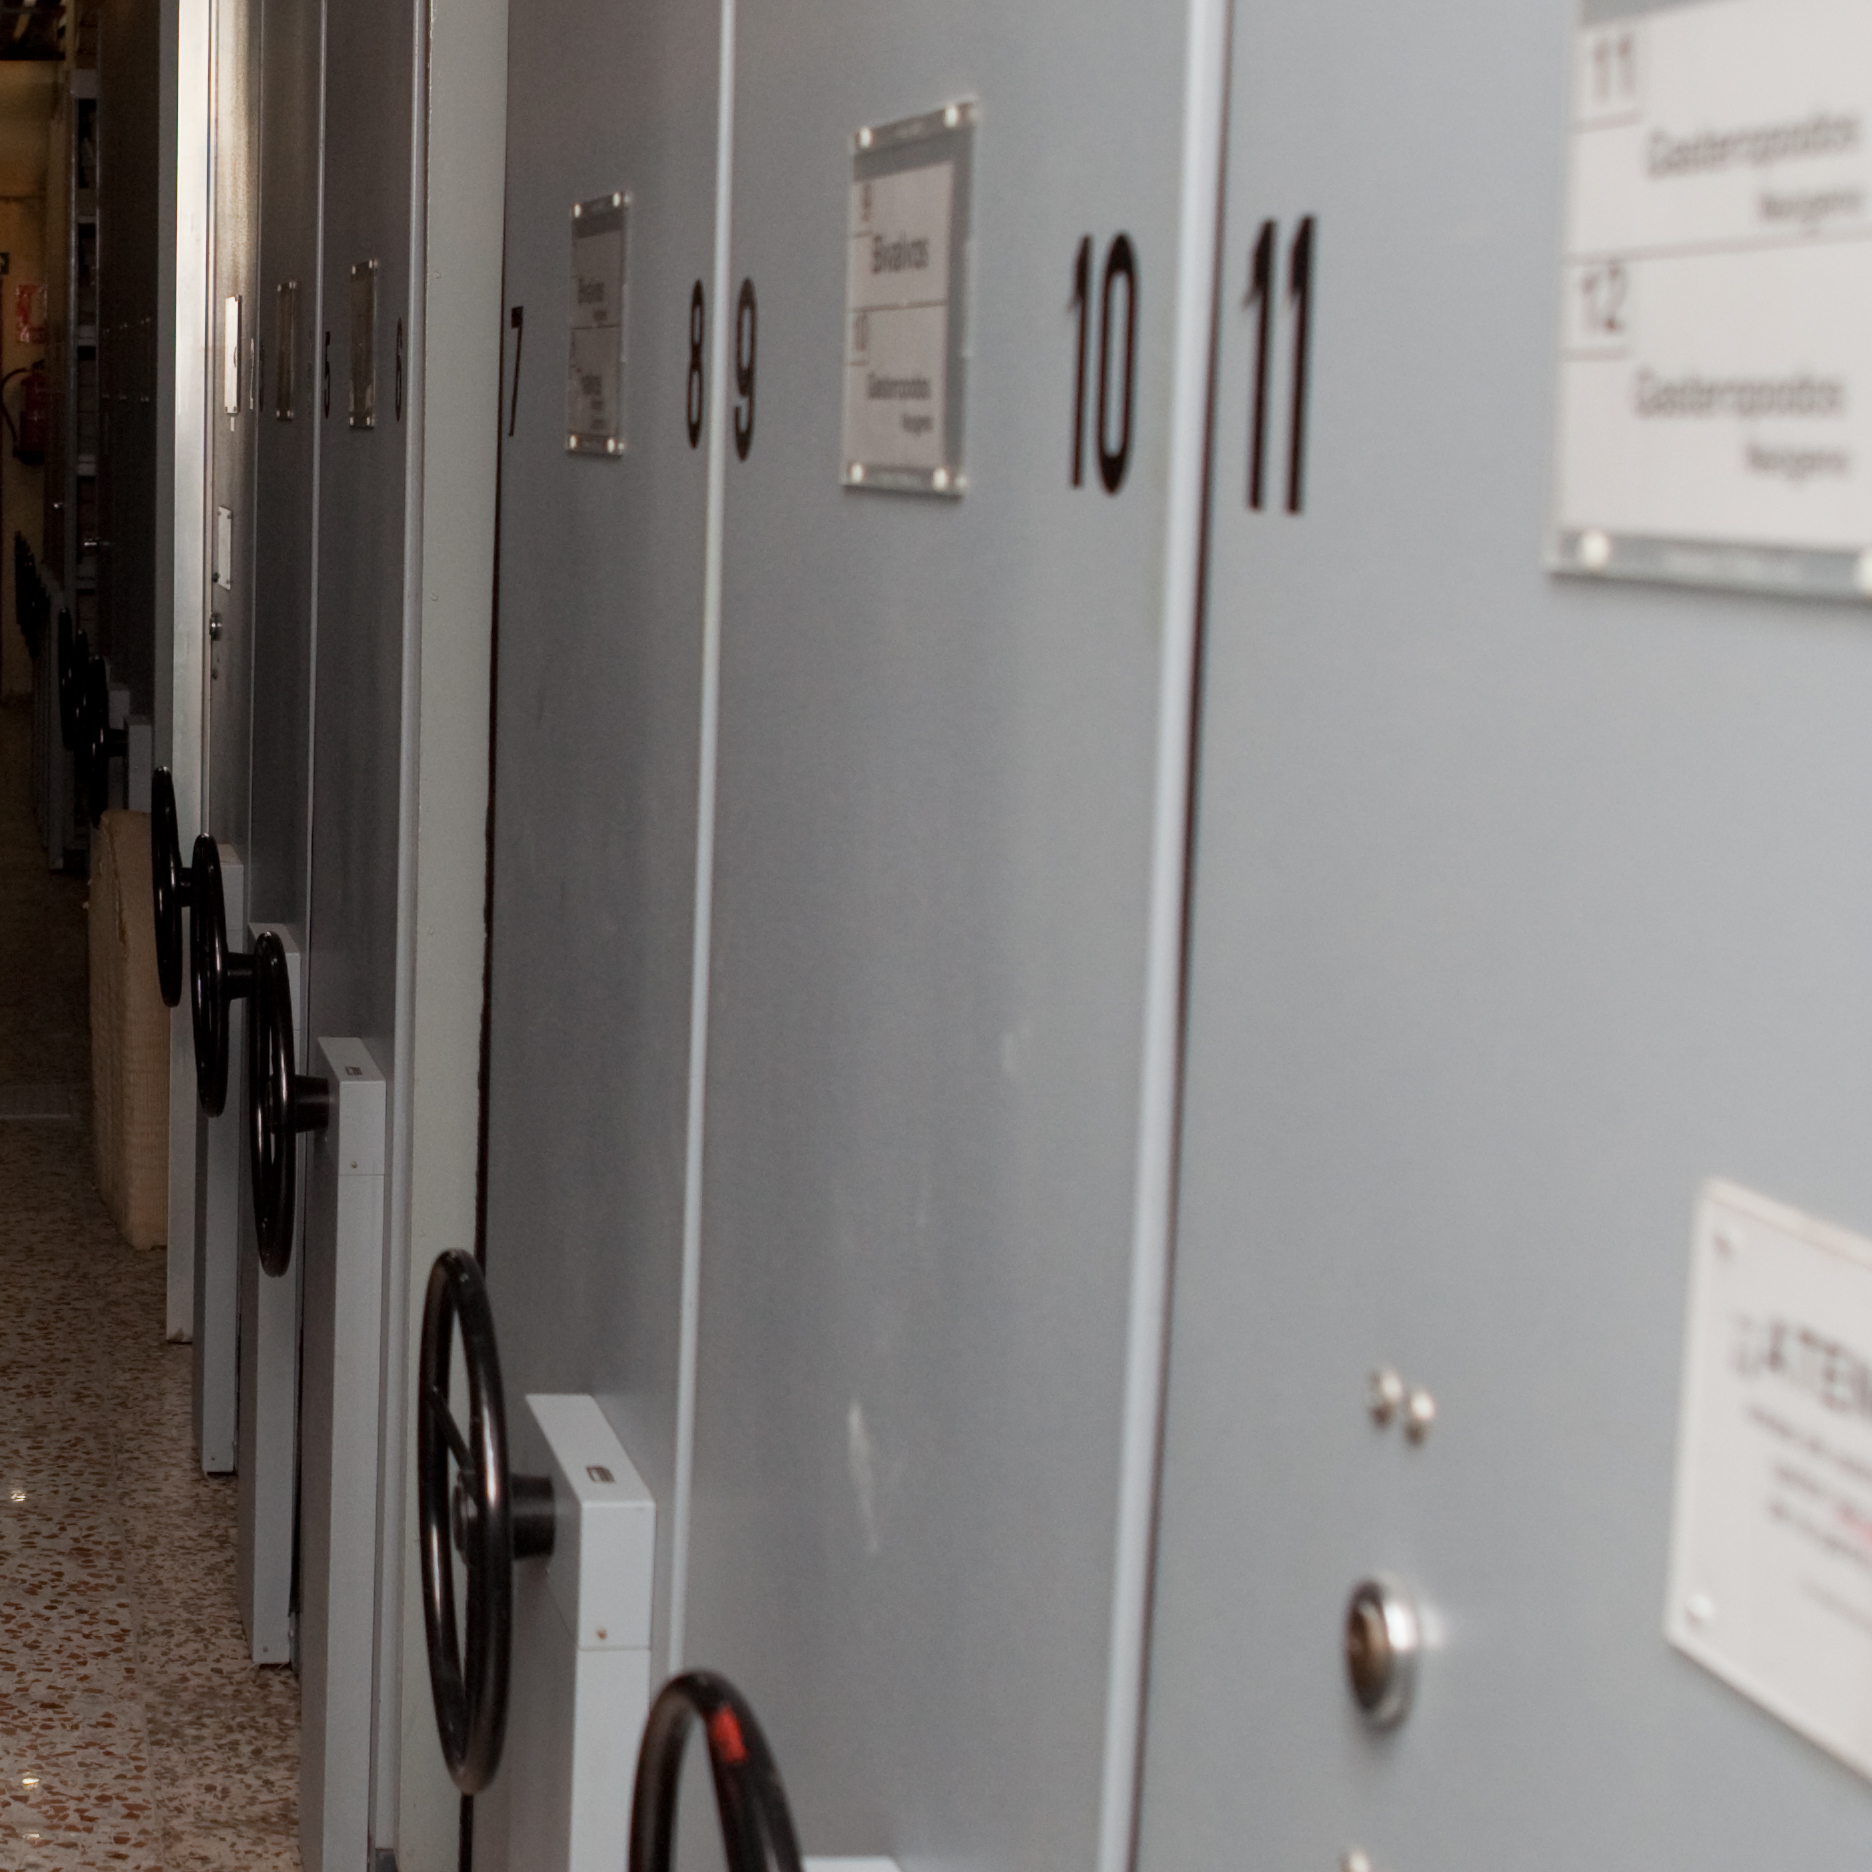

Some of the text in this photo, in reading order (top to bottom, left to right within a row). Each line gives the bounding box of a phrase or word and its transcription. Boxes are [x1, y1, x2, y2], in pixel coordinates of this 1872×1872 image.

[1591, 31, 1637, 105] 11
[324, 330, 331, 419] 5
[395, 317, 403, 422] 6
[508, 305, 524, 437] 7
[687, 279, 705, 450] 8
[735, 278, 757, 463] 9
[1070, 232, 1138, 497] 10
[1244, 215, 1316, 515] 11
